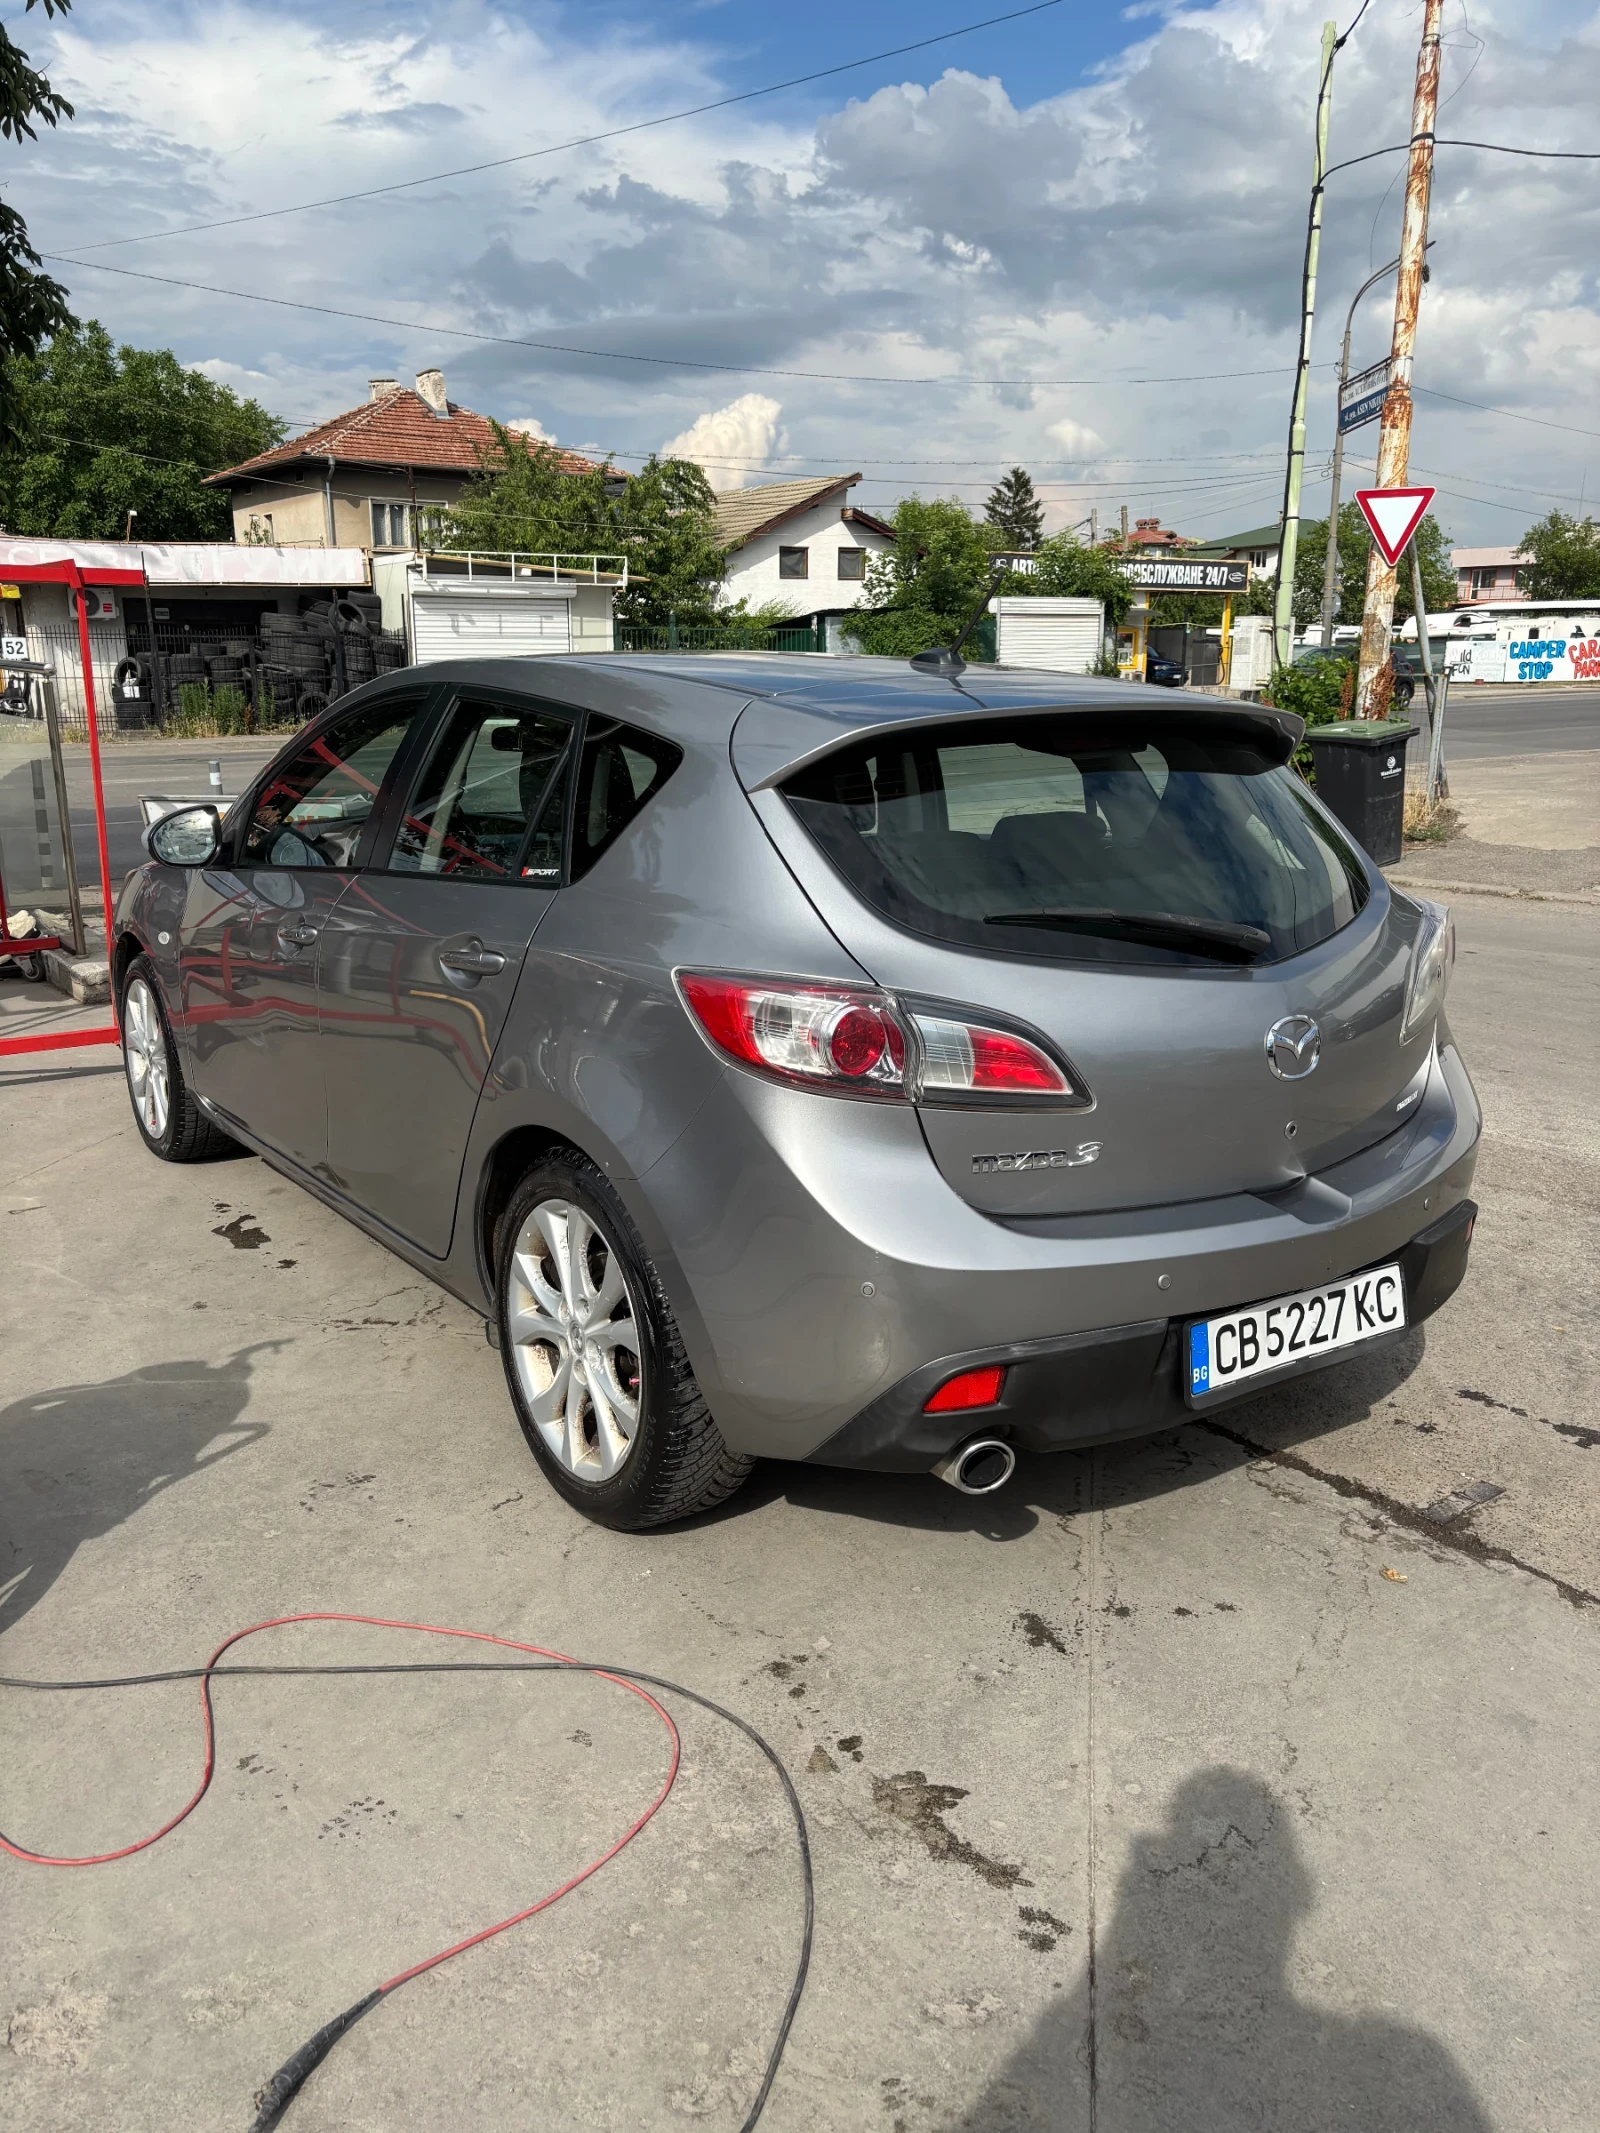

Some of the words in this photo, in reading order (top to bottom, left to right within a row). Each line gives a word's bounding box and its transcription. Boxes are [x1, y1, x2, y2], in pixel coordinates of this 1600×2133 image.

[1205, 566, 1228, 586] 24/7
[5, 641, 25, 655] 52
[1510, 640, 1566, 659] CAMPER
[1518, 661, 1553, 680] STOP
[526, 868, 560, 876] SPORT
[1193, 1365, 1208, 1384] BG
